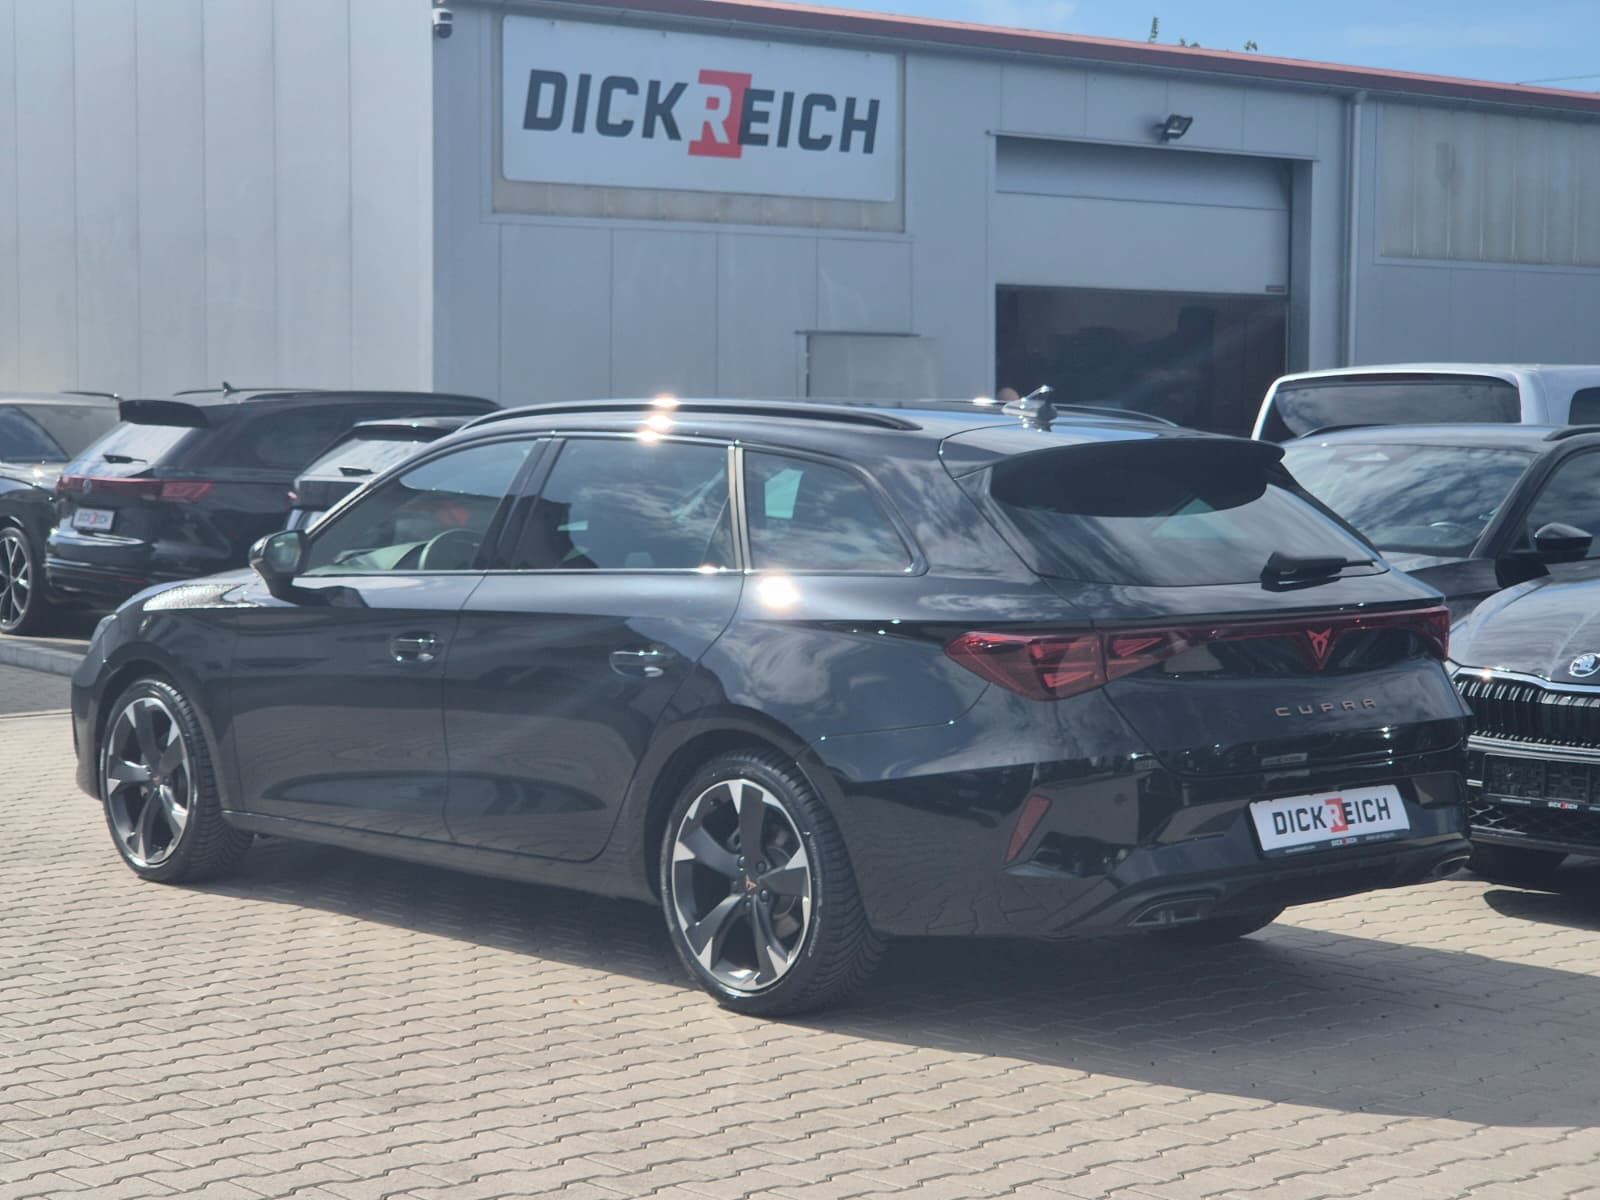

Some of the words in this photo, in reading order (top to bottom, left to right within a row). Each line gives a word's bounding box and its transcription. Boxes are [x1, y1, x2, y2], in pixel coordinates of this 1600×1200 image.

[522, 68, 880, 158] DICKREICH
[1274, 698, 1377, 717] CUPRA
[1272, 797, 1391, 835] DICKREICH
